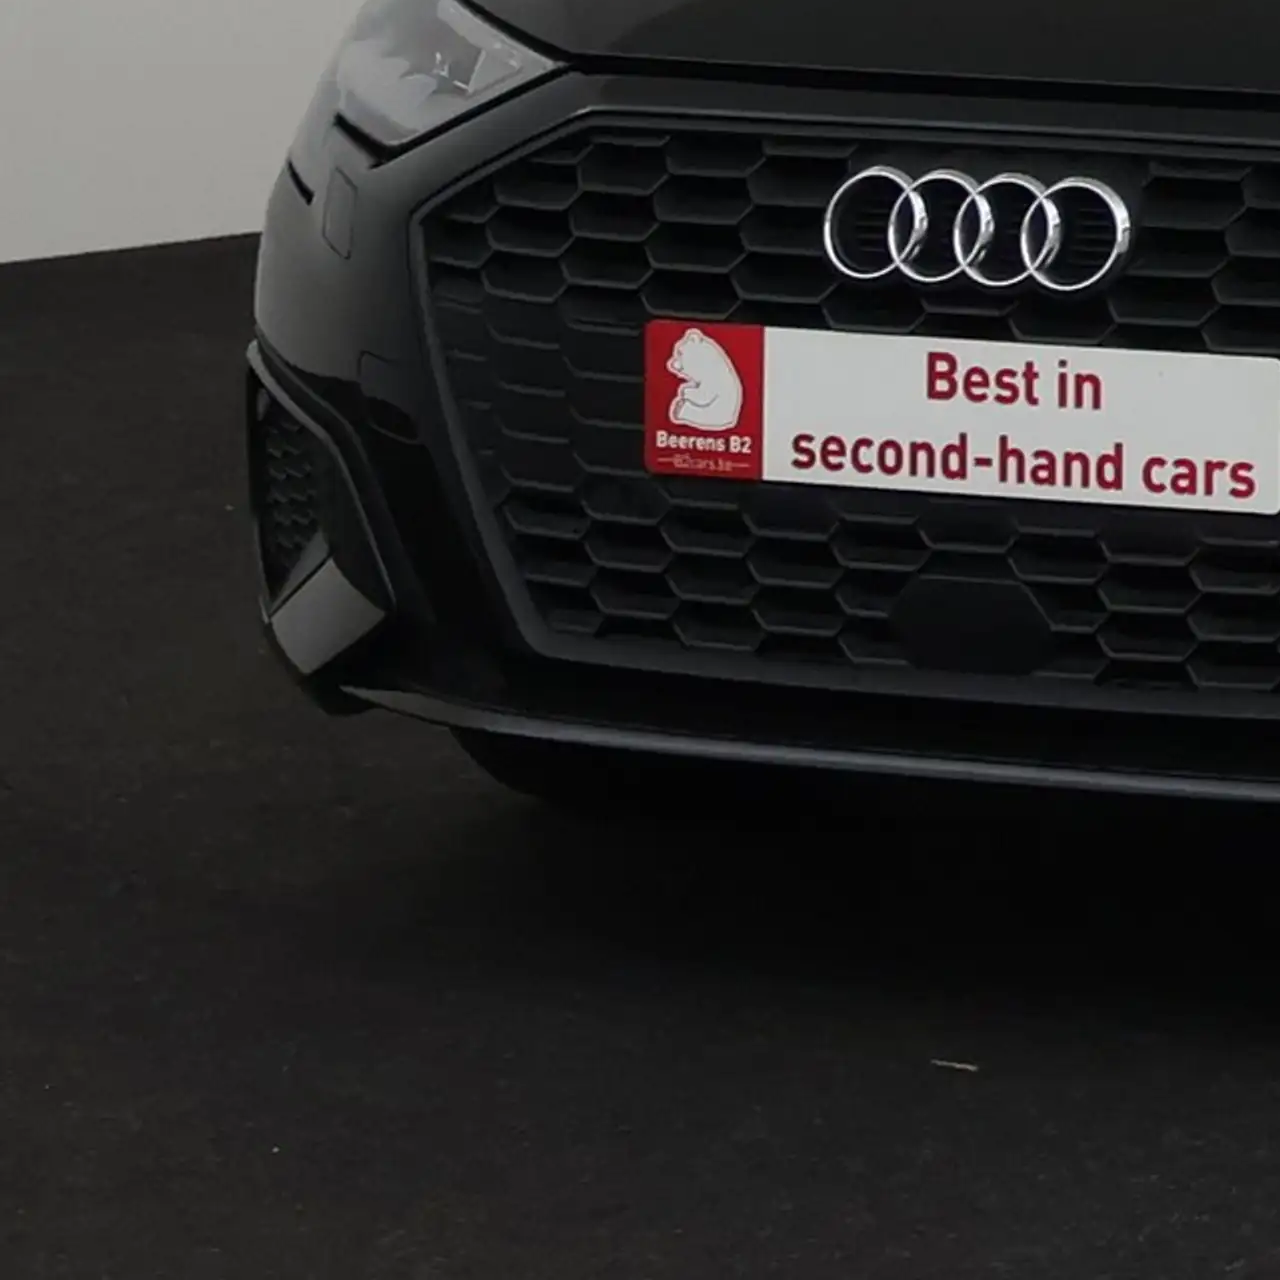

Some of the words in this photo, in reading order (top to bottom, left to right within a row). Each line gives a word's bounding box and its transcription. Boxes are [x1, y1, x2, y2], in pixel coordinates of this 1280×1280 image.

[926, 351, 1040, 406] Best
[1057, 359, 1103, 410] in
[656, 430, 726, 452] Beerens
[729, 435, 752, 454] B2
[790, 432, 1123, 490] second-hand
[1142, 456, 1256, 499] cars
